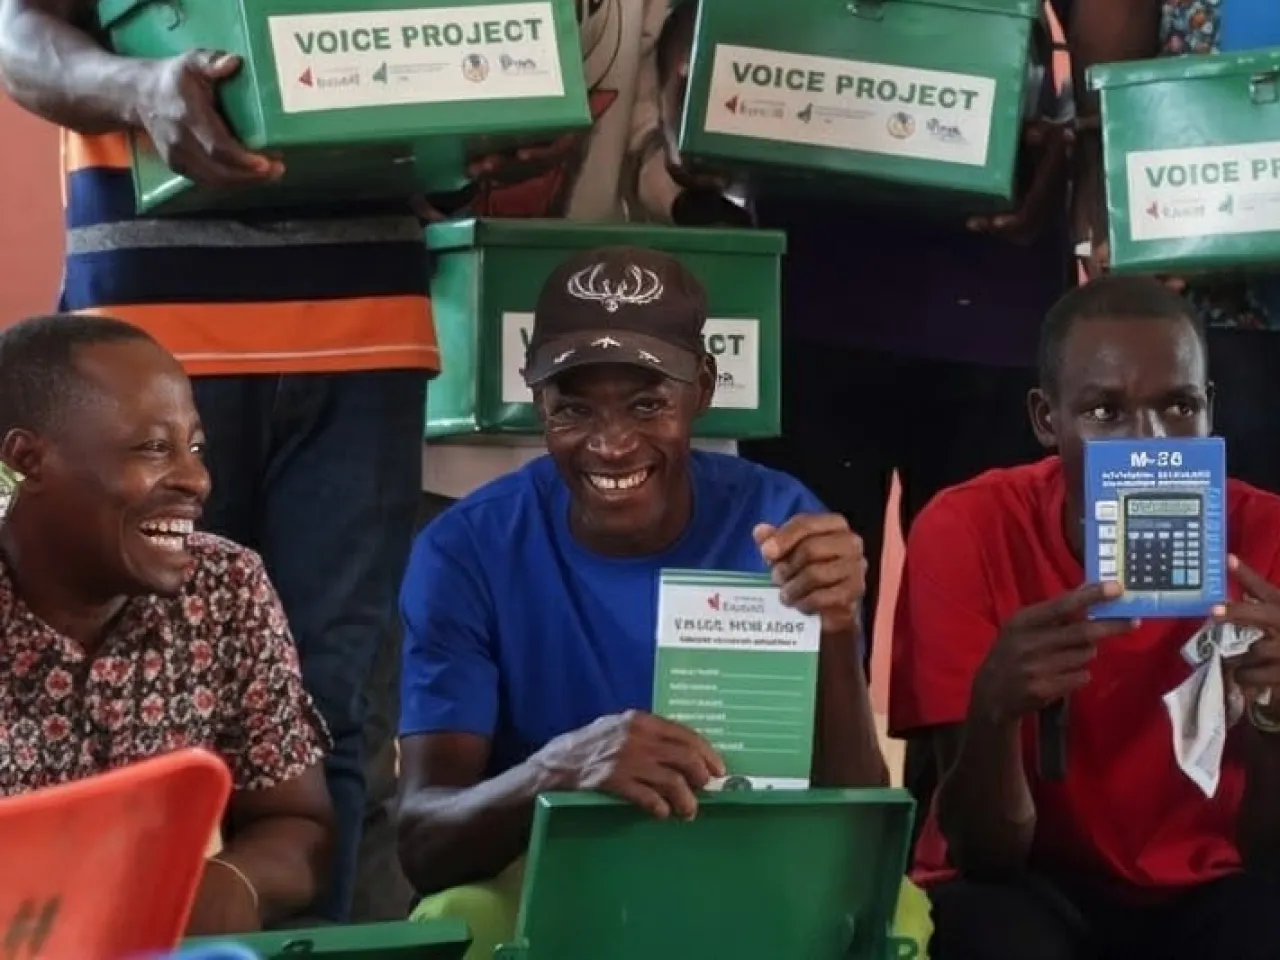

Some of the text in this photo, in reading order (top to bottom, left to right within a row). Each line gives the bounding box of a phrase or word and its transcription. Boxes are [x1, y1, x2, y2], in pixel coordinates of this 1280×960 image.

[294, 19, 543, 54] VOICE PROJECT
[732, 61, 979, 110] VOICE PROJECT
[1145, 160, 1240, 188] VOICE
